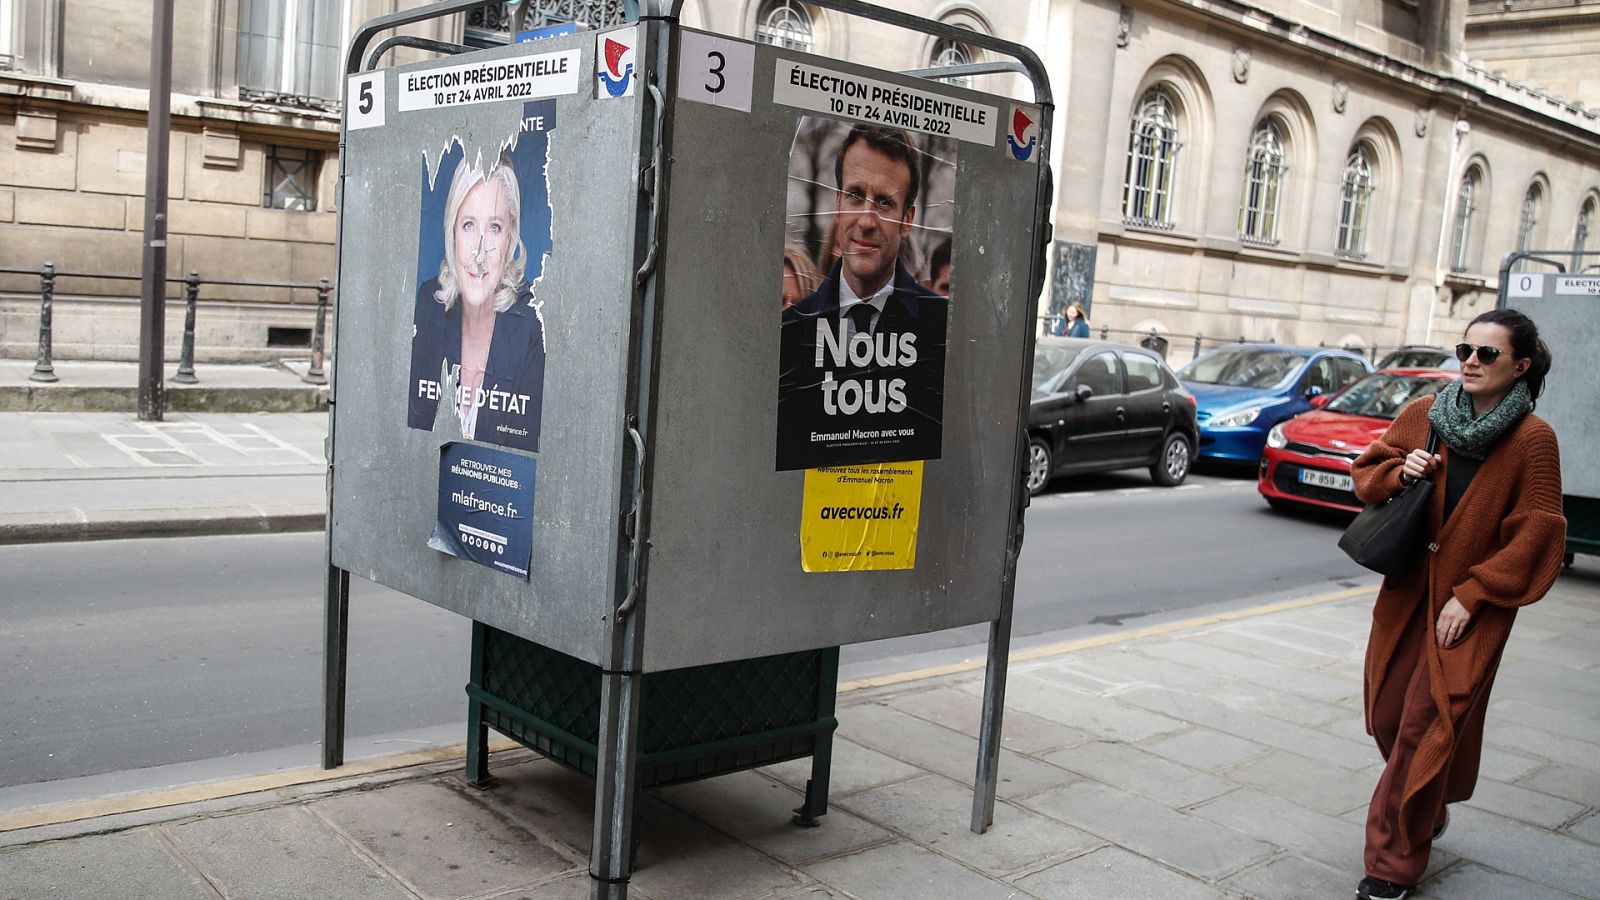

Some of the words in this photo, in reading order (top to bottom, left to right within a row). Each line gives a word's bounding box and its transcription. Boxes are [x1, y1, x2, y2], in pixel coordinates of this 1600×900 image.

[408, 72, 460, 92] ÉLECTION
[464, 58, 568, 85] PRÉSIDENTIELLE
[704, 51, 726, 93] 3
[358, 81, 373, 114] 5
[434, 93, 444, 105] 10
[446, 93, 457, 104] ET
[459, 89, 471, 102] 24
[473, 86, 504, 101] AVRIL
[507, 82, 532, 97] 2022
[790, 65, 868, 99] ÉLECTION
[872, 87, 986, 125] PRÉSIDENTIELLE
[830, 98, 844, 113] 10
[847, 104, 861, 116] ET
[864, 105, 880, 120] 24
[883, 110, 920, 129] AVRIL
[923, 118, 951, 135] 2022
[814, 317, 918, 368] Nous
[418, 379, 472, 406] FEE
[821, 371, 908, 416] tous
[810, 430, 851, 442] Emmanuel
[852, 429, 880, 439] Macron
[898, 428, 915, 436] vous
[451, 464, 482, 480] RÉUNIONS
[483, 474, 519, 489] PUBLIQUES
[460, 458, 497, 474] RETROUVEZ
[497, 468, 512, 478] MES
[870, 468, 913, 476] rasemblements
[452, 490, 518, 518] mlafrance.fr
[820, 502, 904, 520] avecvous.fr
